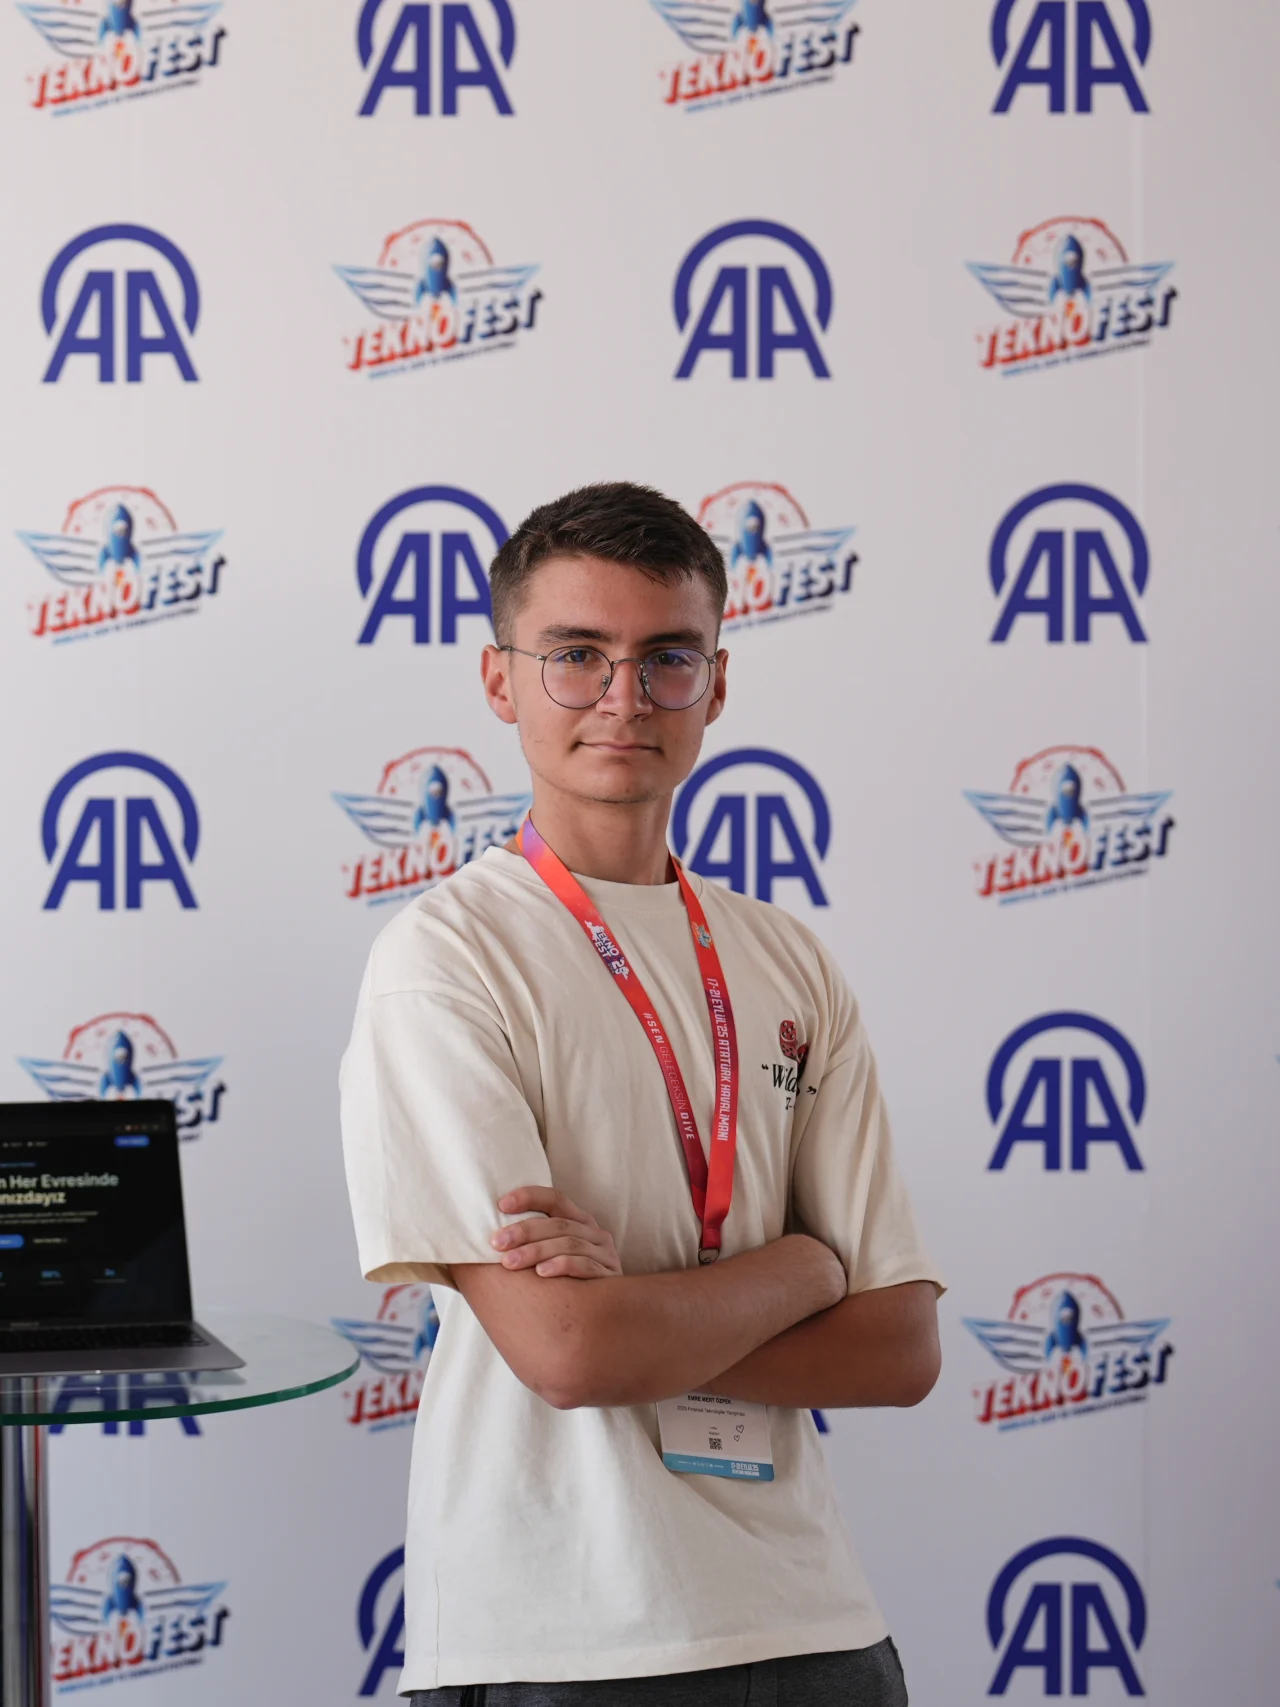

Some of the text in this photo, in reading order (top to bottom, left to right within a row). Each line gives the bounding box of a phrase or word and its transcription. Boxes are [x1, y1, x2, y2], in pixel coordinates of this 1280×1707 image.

[25, 27, 227, 110] TEKNOFEST
[360, 3, 513, 116] AA
[656, 22, 860, 106] TEKNOFEST
[994, 1, 1148, 113] AA
[44, 271, 198, 383] AA
[341, 289, 543, 372] TEKNOFEST
[676, 267, 829, 379] AA
[973, 286, 1177, 370] TEKNOFEST
[25, 555, 227, 638] TEKNOFEST
[992, 531, 1147, 643] AA
[44, 798, 197, 911] AA
[971, 815, 1175, 899] TEKNOFEST
[643, 1012, 665, 1044] #SEN
[680, 1112, 696, 1140] DİYE
[718, 1039, 732, 1082] ATATÜRK
[716, 1084, 731, 1141] HAVALİMANI
[989, 1058, 1143, 1171] AA
[9, 1174, 39, 1190] Her
[41, 1172, 119, 1189] Evresinde
[972, 1342, 1174, 1425] TEKNOFEST
[51, 1608, 229, 1682] EKNOFEST
[989, 1584, 1143, 1696] AA
